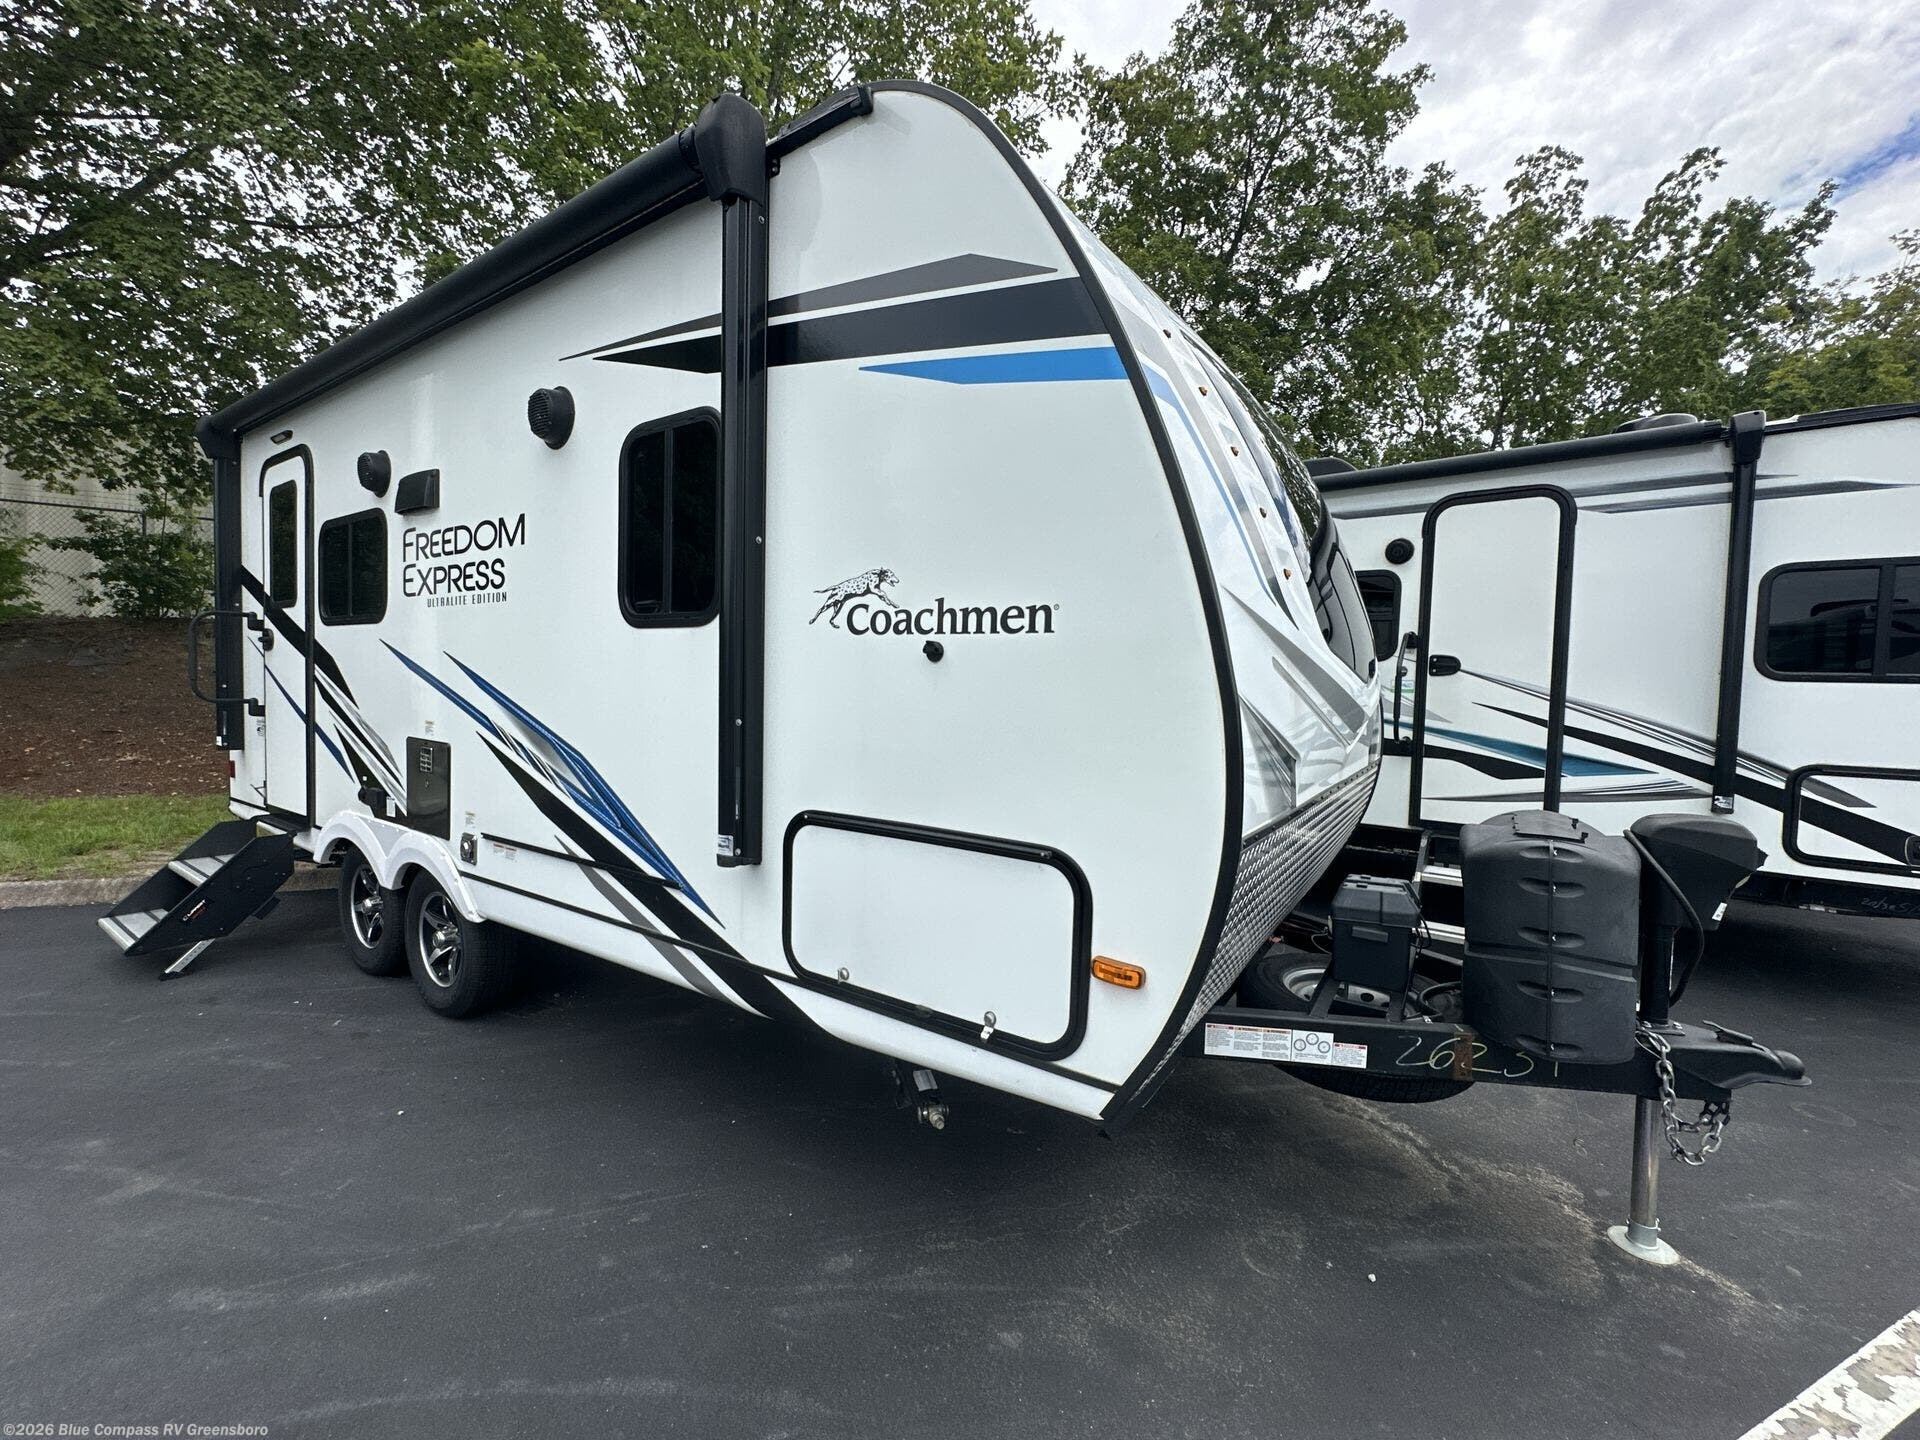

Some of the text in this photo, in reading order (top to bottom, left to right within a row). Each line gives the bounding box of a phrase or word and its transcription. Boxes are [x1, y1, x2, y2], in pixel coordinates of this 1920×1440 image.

[402, 513, 526, 562] FREEDOM
[402, 558, 506, 597] EXPRESS
[427, 592, 507, 608] ULTRALITE EDITION
[846, 597, 1055, 636] Coachmen
